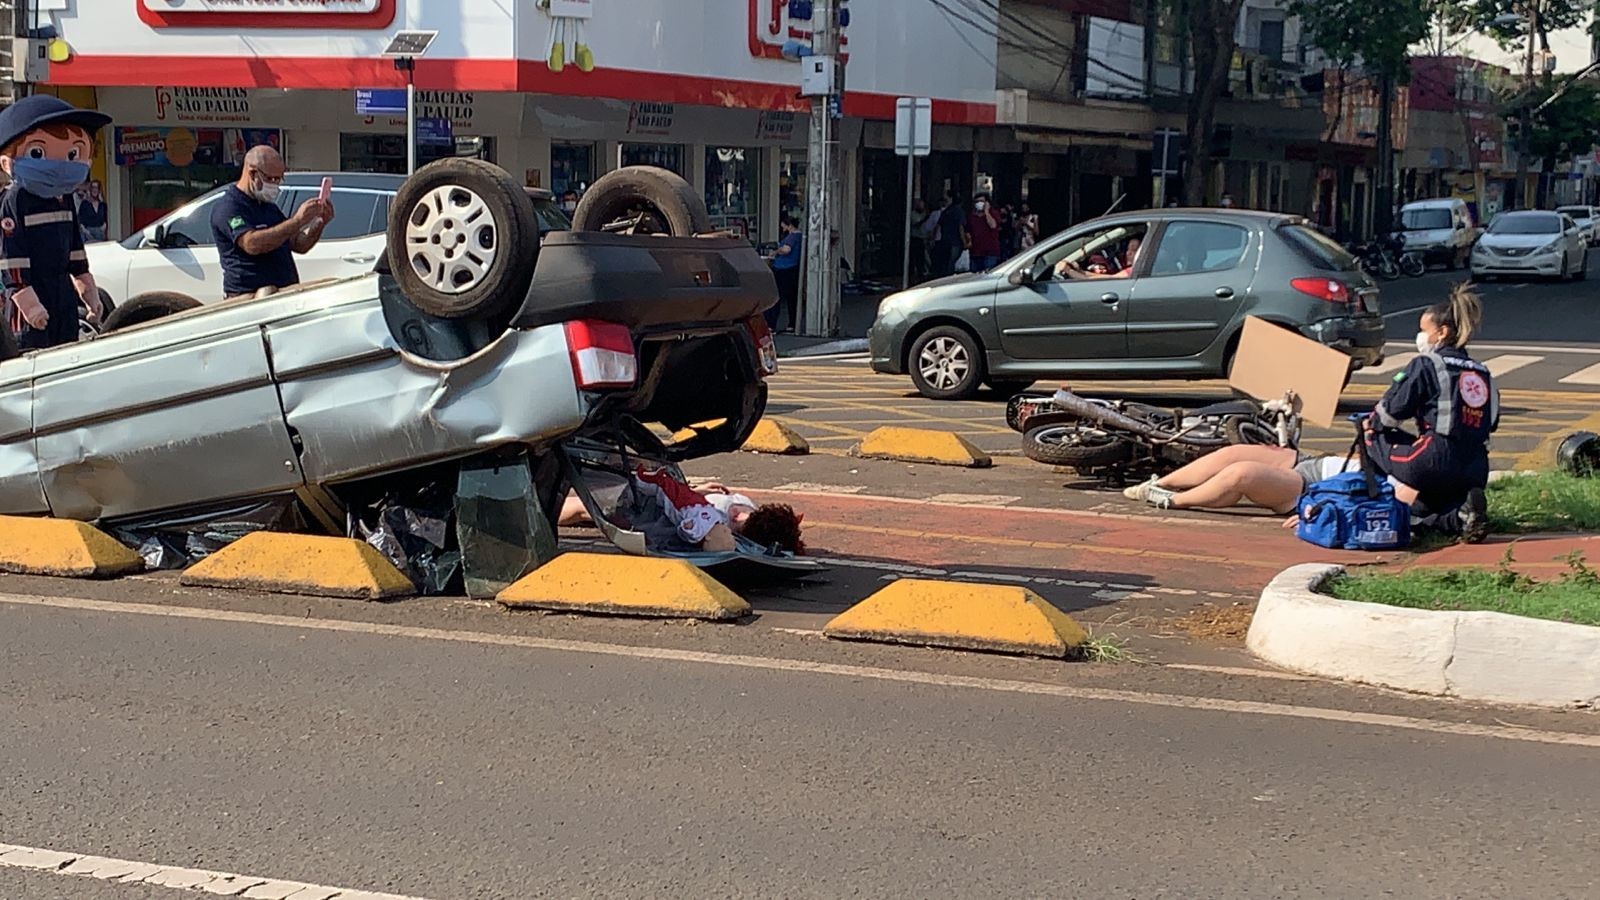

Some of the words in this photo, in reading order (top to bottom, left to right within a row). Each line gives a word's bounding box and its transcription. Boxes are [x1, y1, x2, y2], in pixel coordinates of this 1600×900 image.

[175, 98, 201, 112] SÃO
[205, 100, 249, 113] PAULO
[423, 106, 473, 119] PAULO
[119, 140, 165, 154] PREMIADO
[1366, 520, 1391, 531] 192
